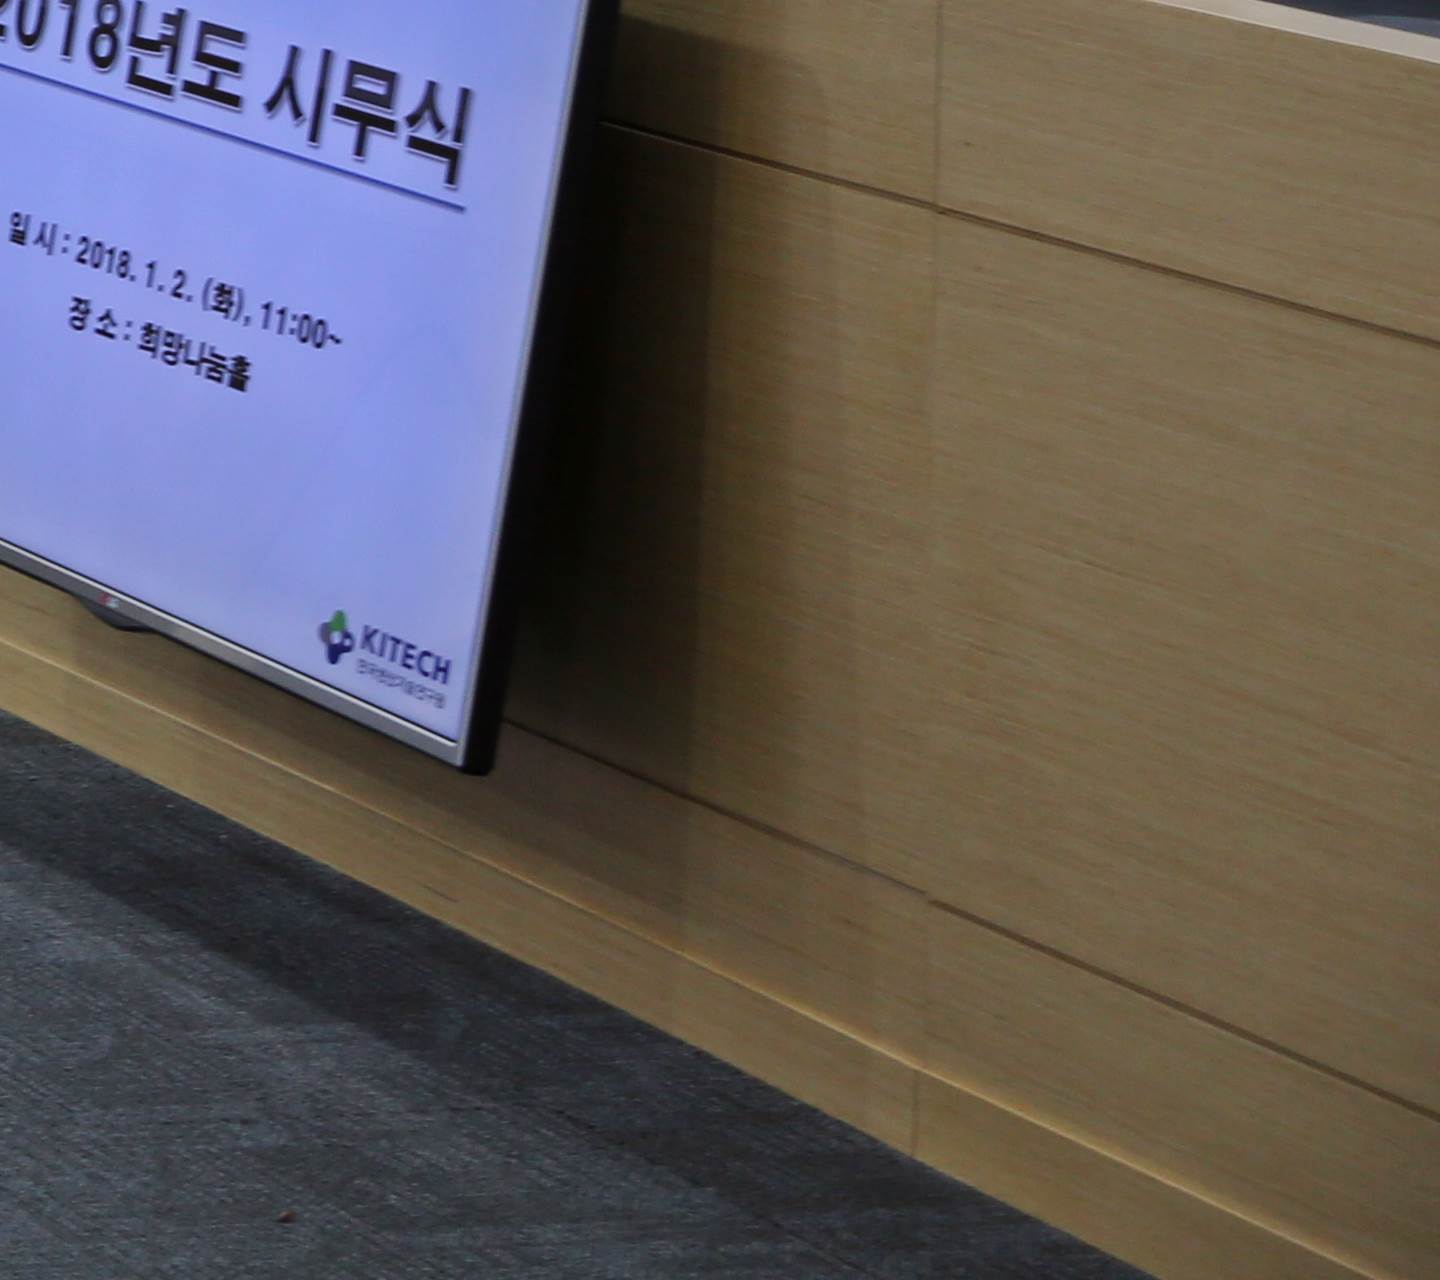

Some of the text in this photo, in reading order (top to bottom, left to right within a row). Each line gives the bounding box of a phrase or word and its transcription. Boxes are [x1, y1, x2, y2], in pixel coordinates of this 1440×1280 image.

[263, 43, 474, 190] 시무식
[75, 235, 136, 282] 2018.
[261, 301, 343, 349] 11:00~
[138, 322, 252, 393] 희망나눔홀
[360, 624, 452, 684] KITECH
